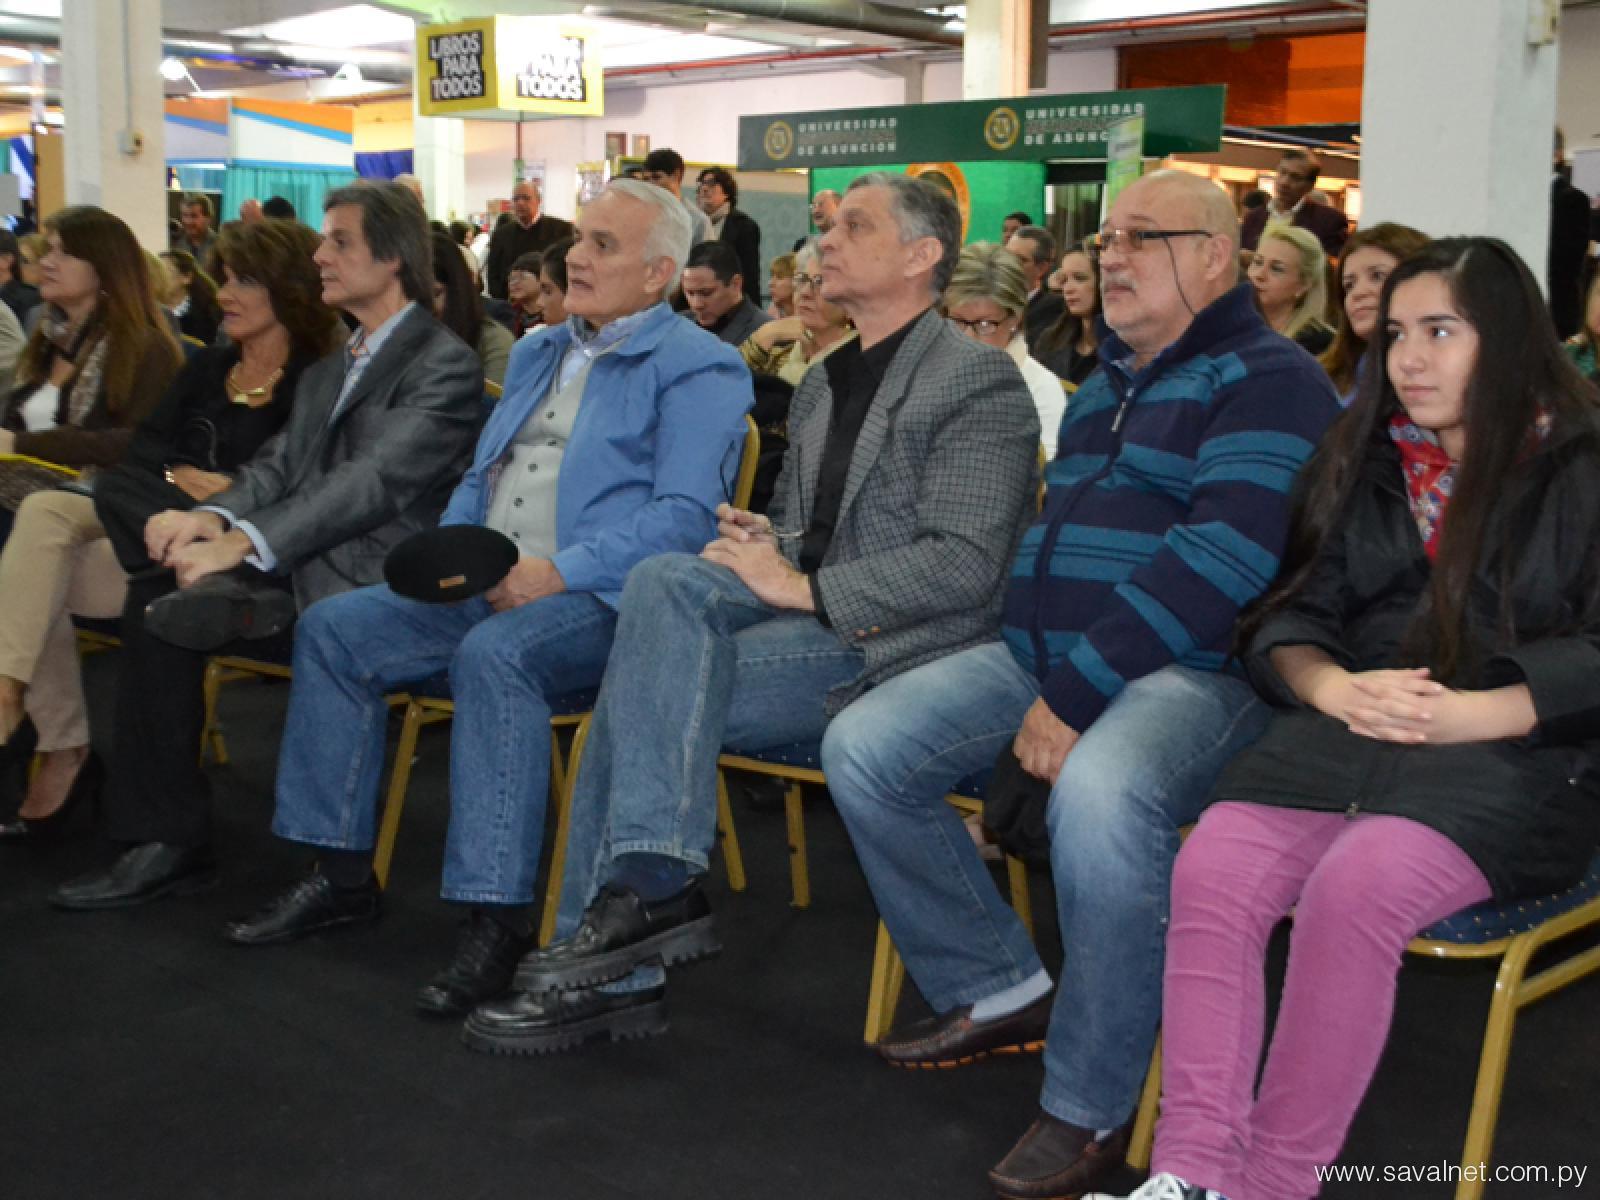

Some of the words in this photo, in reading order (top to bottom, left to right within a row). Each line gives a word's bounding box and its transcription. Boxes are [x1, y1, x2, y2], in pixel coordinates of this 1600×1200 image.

[431, 32, 480, 58] LIBROS
[443, 54, 479, 76] PARA
[432, 74, 481, 99] TODOS
[518, 74, 582, 99] TODOS
[1025, 102, 1145, 119] UNIVERSIDAD
[798, 117, 897, 133] UNIVERSIDAD
[1024, 134, 1045, 145] DE
[1052, 132, 1109, 144] ASUNC
[798, 145, 815, 156] DE
